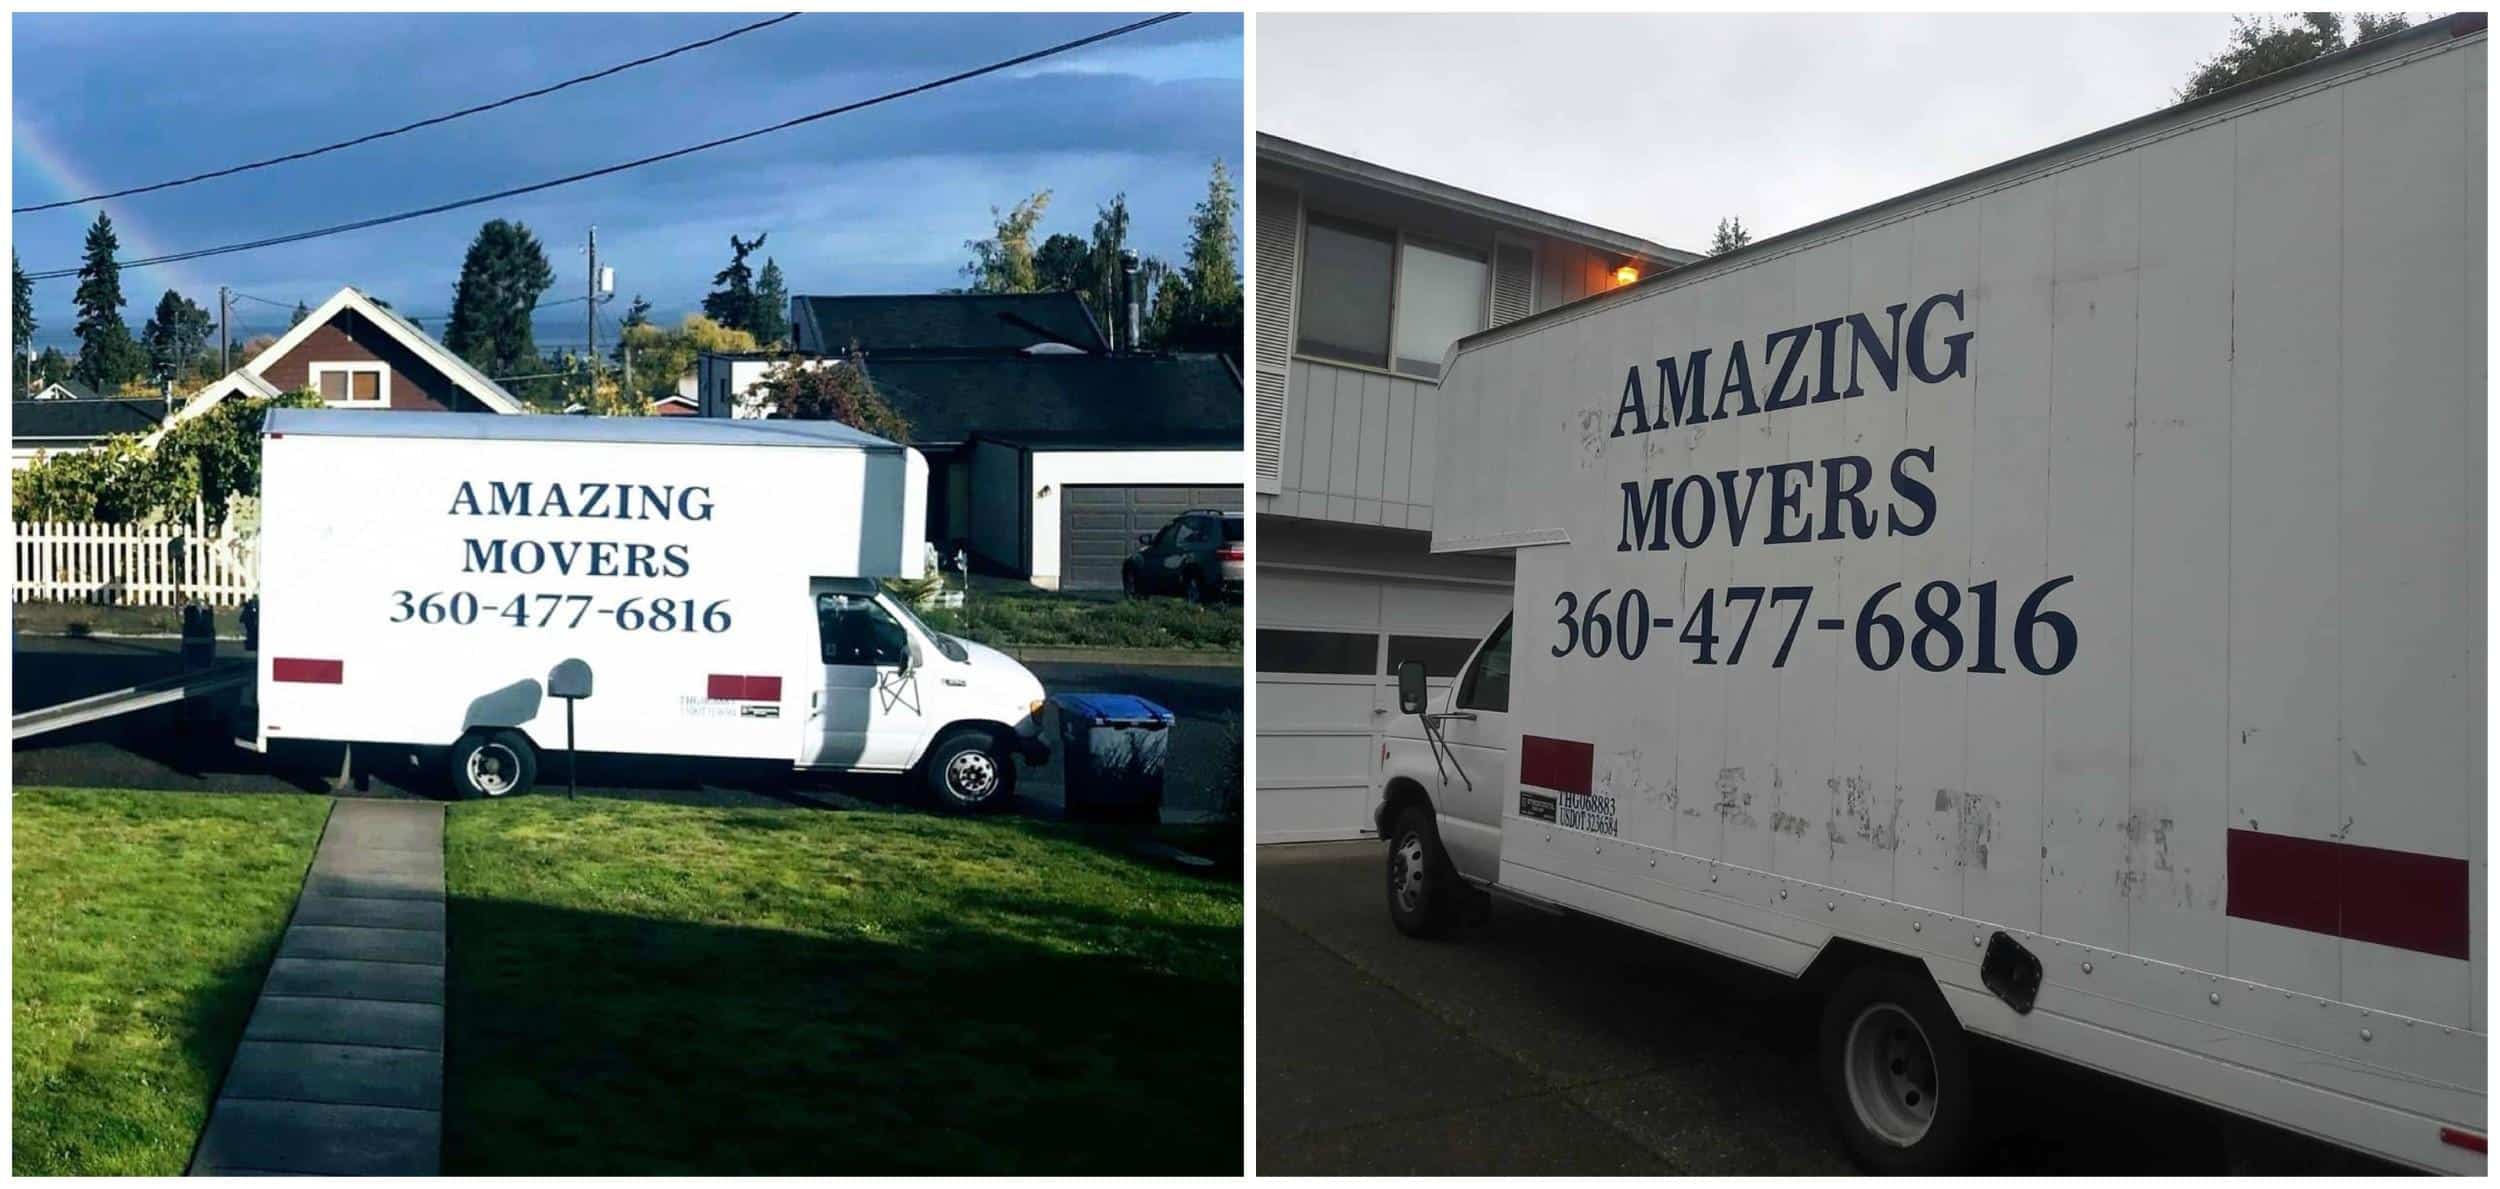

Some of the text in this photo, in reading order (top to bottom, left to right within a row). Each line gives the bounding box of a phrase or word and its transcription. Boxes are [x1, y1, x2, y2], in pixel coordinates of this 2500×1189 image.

[1610, 289, 1975, 439] AMAZING
[448, 481, 715, 521] AMAZING
[1616, 446, 1937, 552] MOVERS
[461, 538, 690, 578] MOVERS
[389, 590, 732, 634] 360-477-6816
[1551, 575, 2079, 676] 360-477-6816
